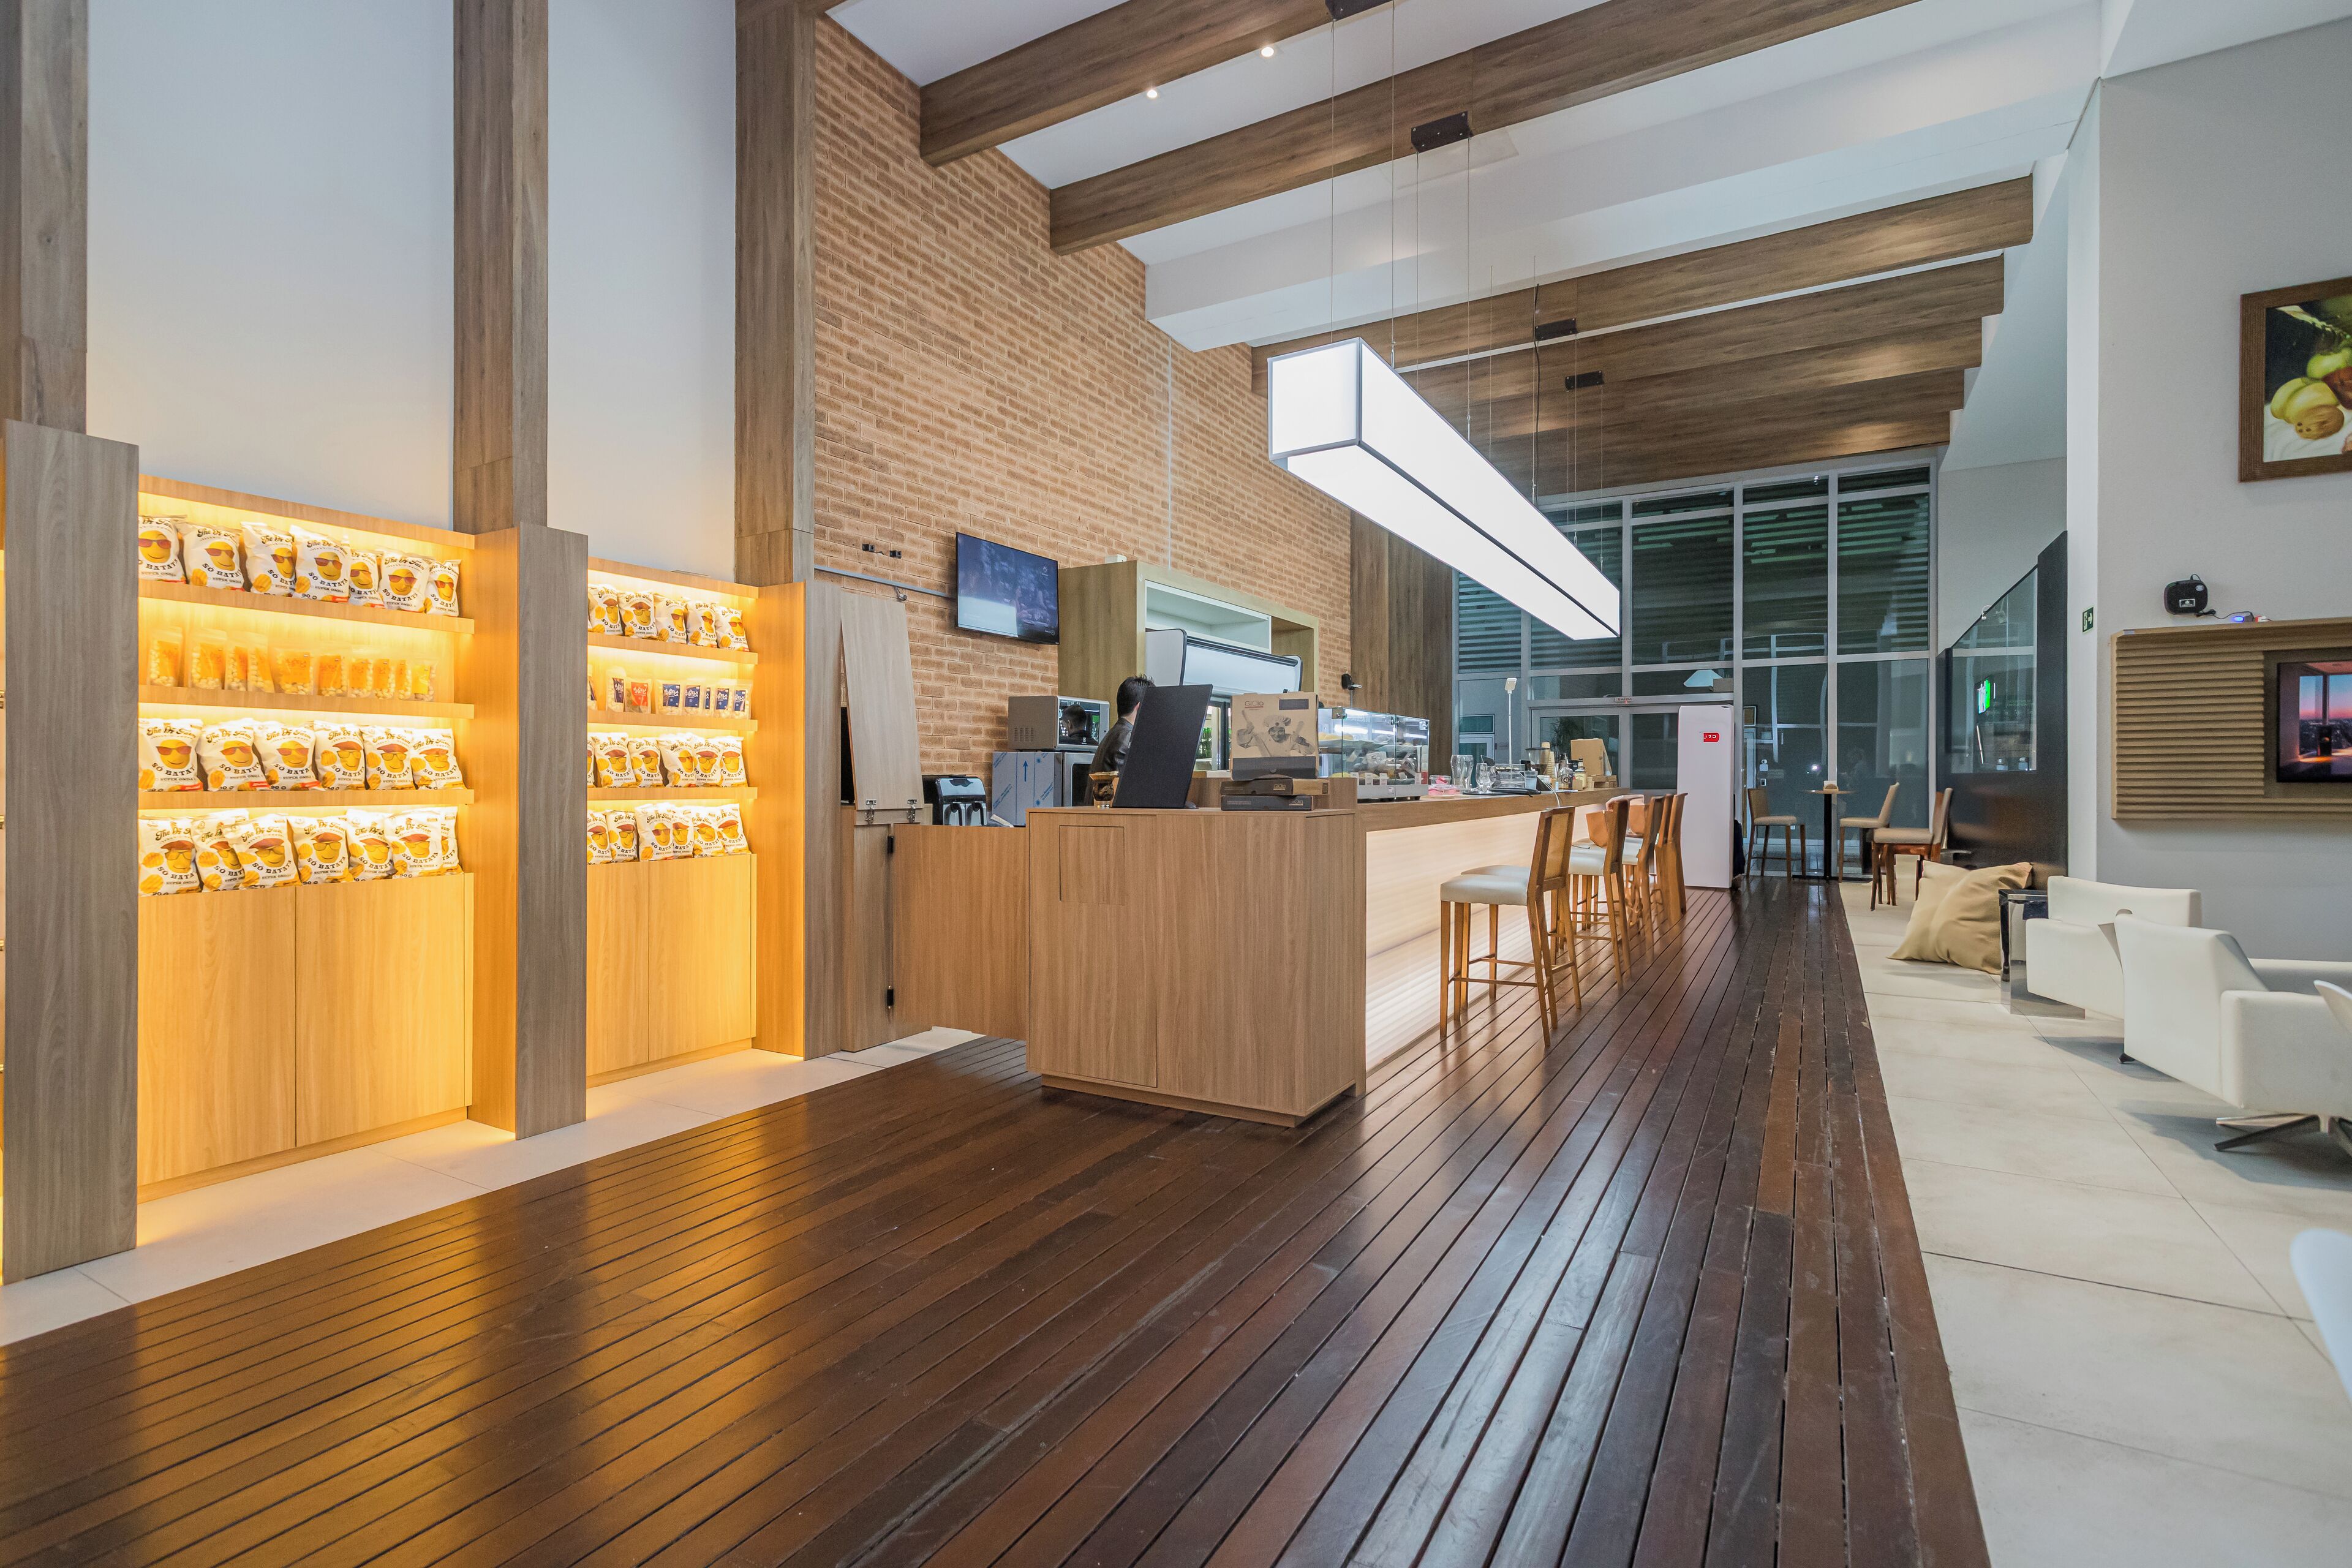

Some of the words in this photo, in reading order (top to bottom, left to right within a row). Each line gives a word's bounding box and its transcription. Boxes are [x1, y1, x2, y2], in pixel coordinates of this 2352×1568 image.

[146, 726, 162, 736] The
[155, 829, 170, 841] The
[318, 856, 345, 869] BATATA
